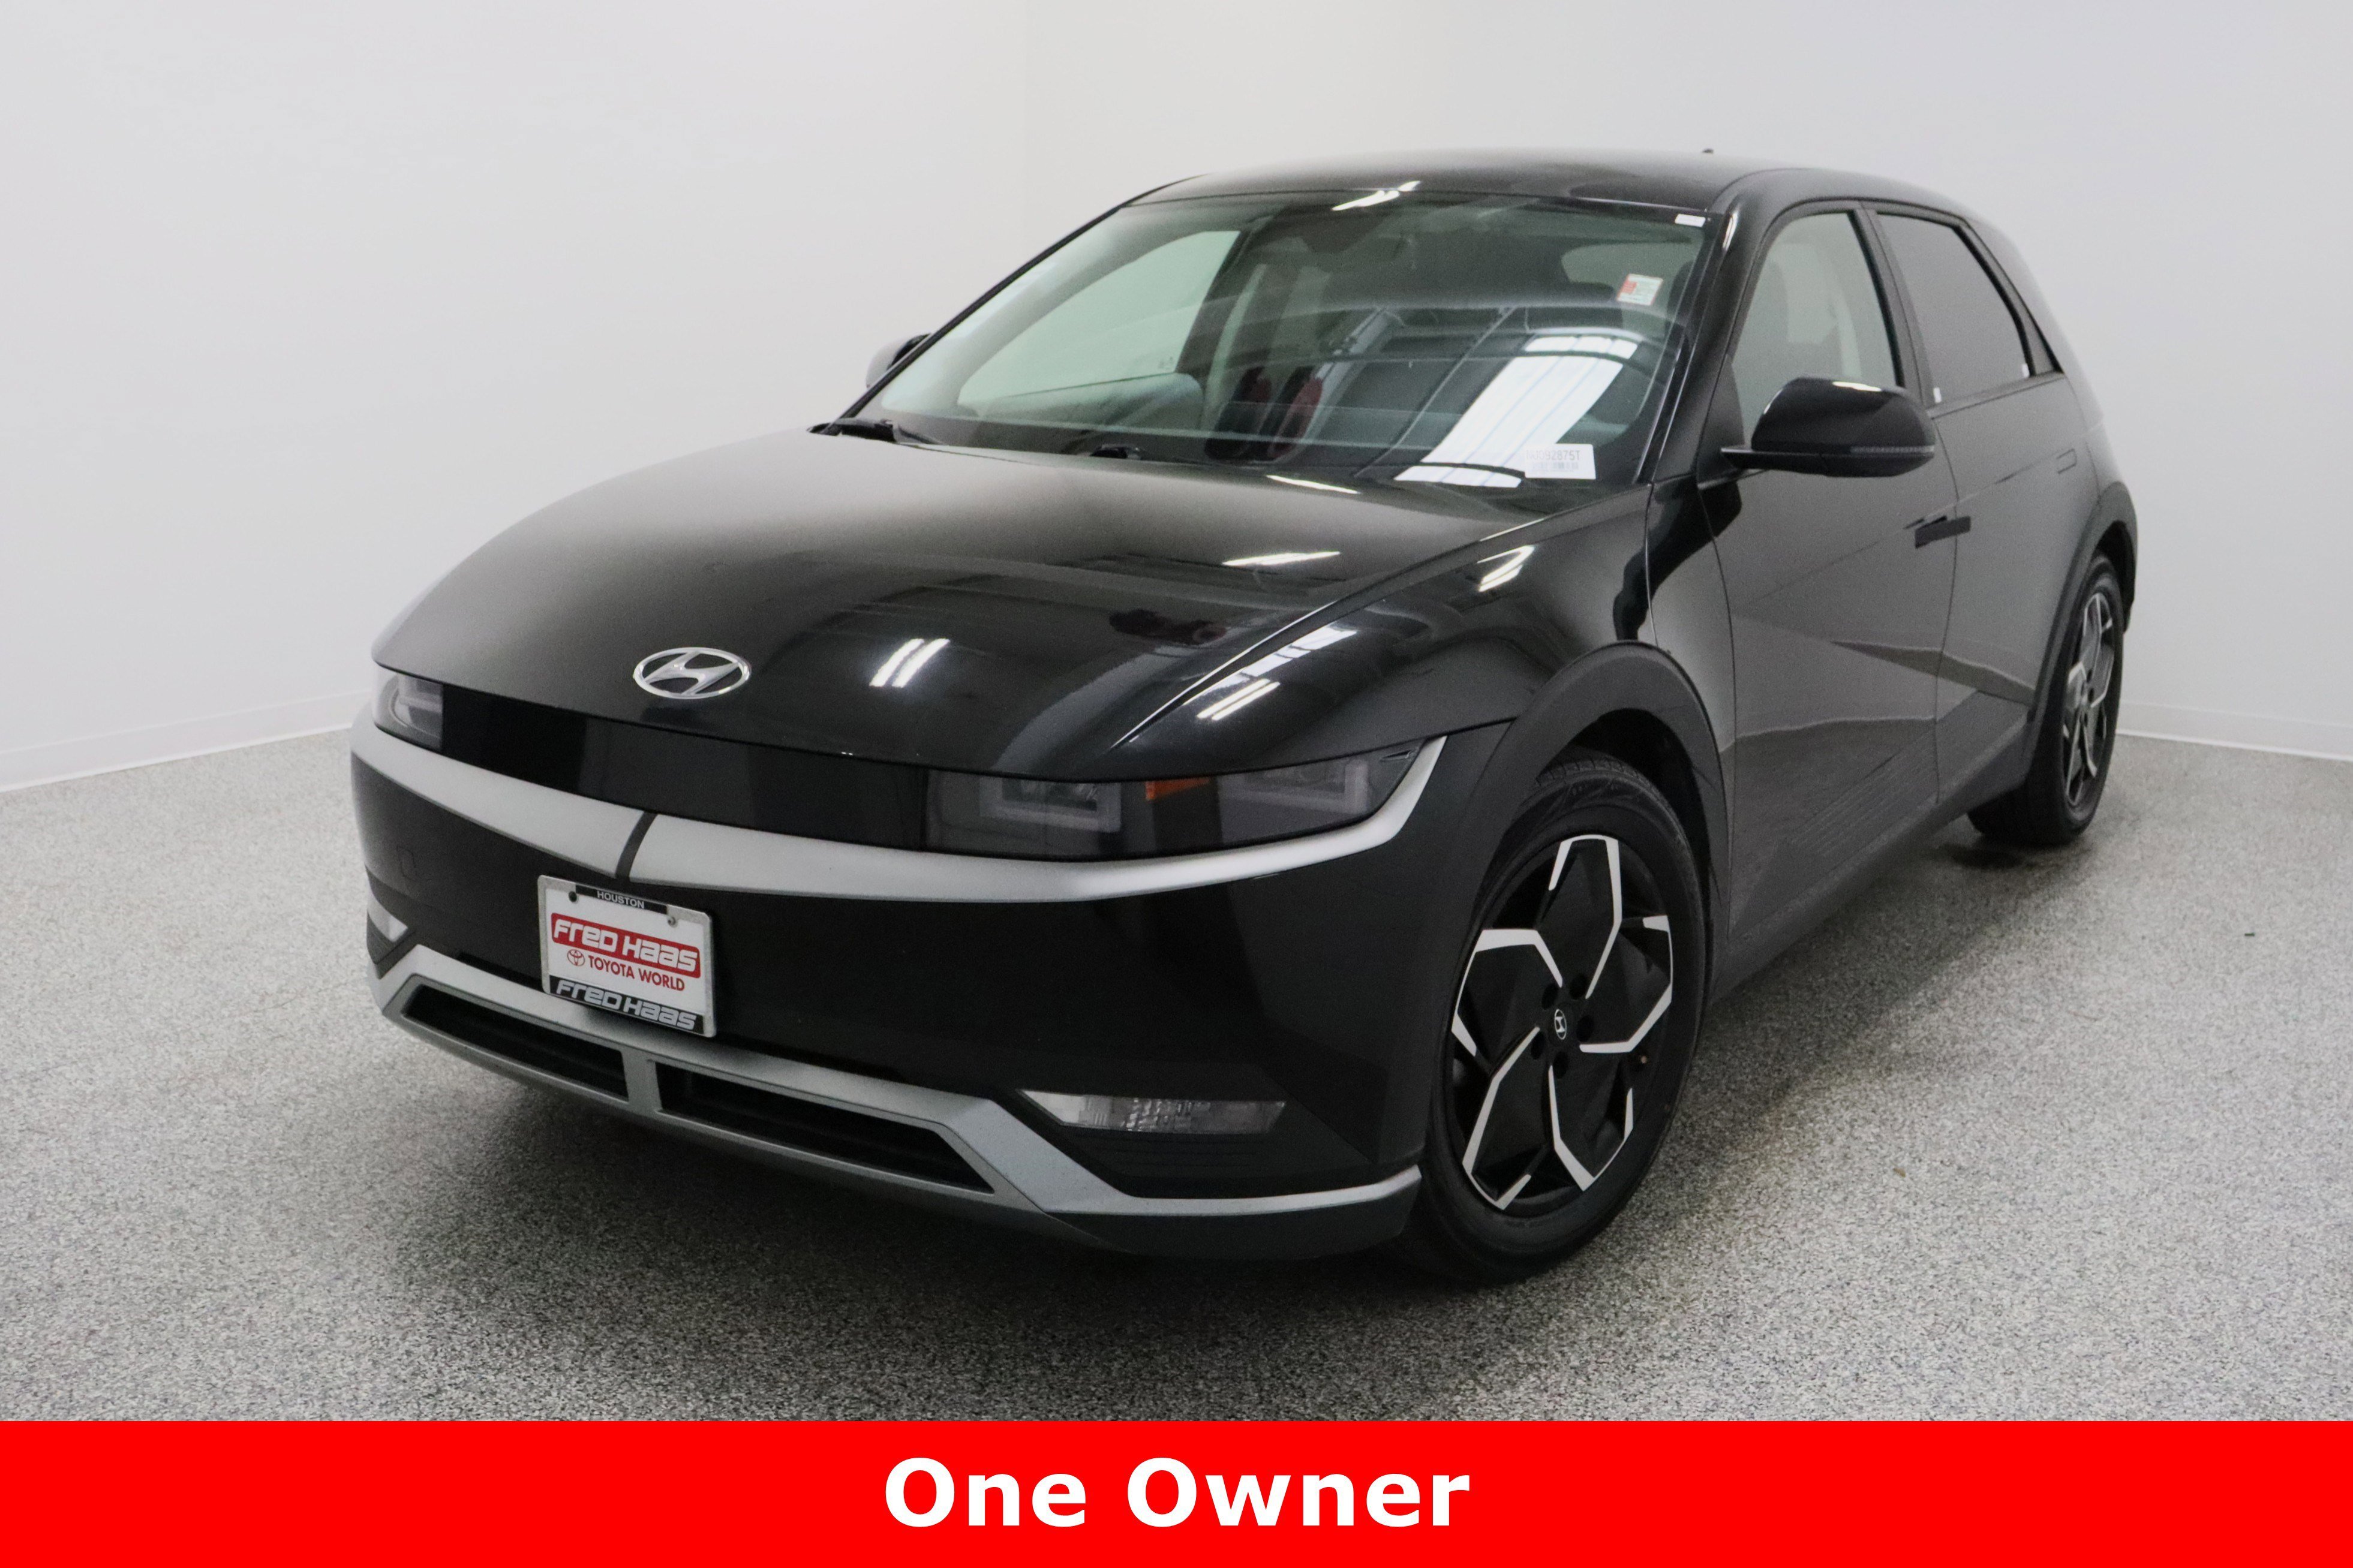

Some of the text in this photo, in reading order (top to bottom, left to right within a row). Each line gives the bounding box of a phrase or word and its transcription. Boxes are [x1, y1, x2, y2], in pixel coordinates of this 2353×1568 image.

[597, 890, 645, 909] HOUSTON
[588, 955, 685, 991] TOYOTA WORLD
